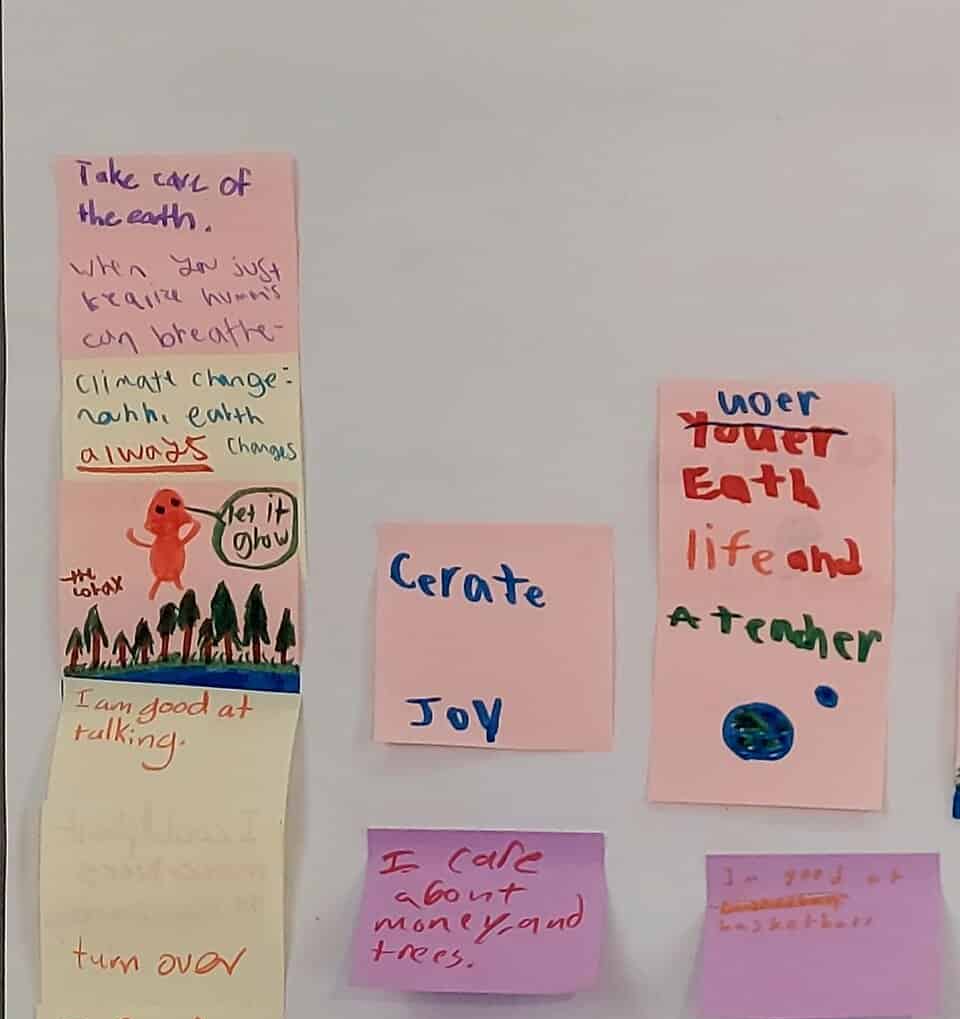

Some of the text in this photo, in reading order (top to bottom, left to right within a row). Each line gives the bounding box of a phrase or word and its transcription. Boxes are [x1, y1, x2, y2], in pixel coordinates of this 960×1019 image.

[76, 157, 252, 196] Take of
[79, 200, 211, 233] the earth.
[233, 256, 281, 282] just
[80, 435, 209, 464] always
[267, 495, 290, 524] it
[688, 523, 862, 578] life and
[390, 552, 546, 608] Cerate
[75, 688, 253, 724] I am good at
[74, 717, 185, 771] talking.
[379, 850, 419, 874] I
[394, 880, 527, 909] about
[518, 894, 583, 934] and
[73, 936, 247, 976] turn over
